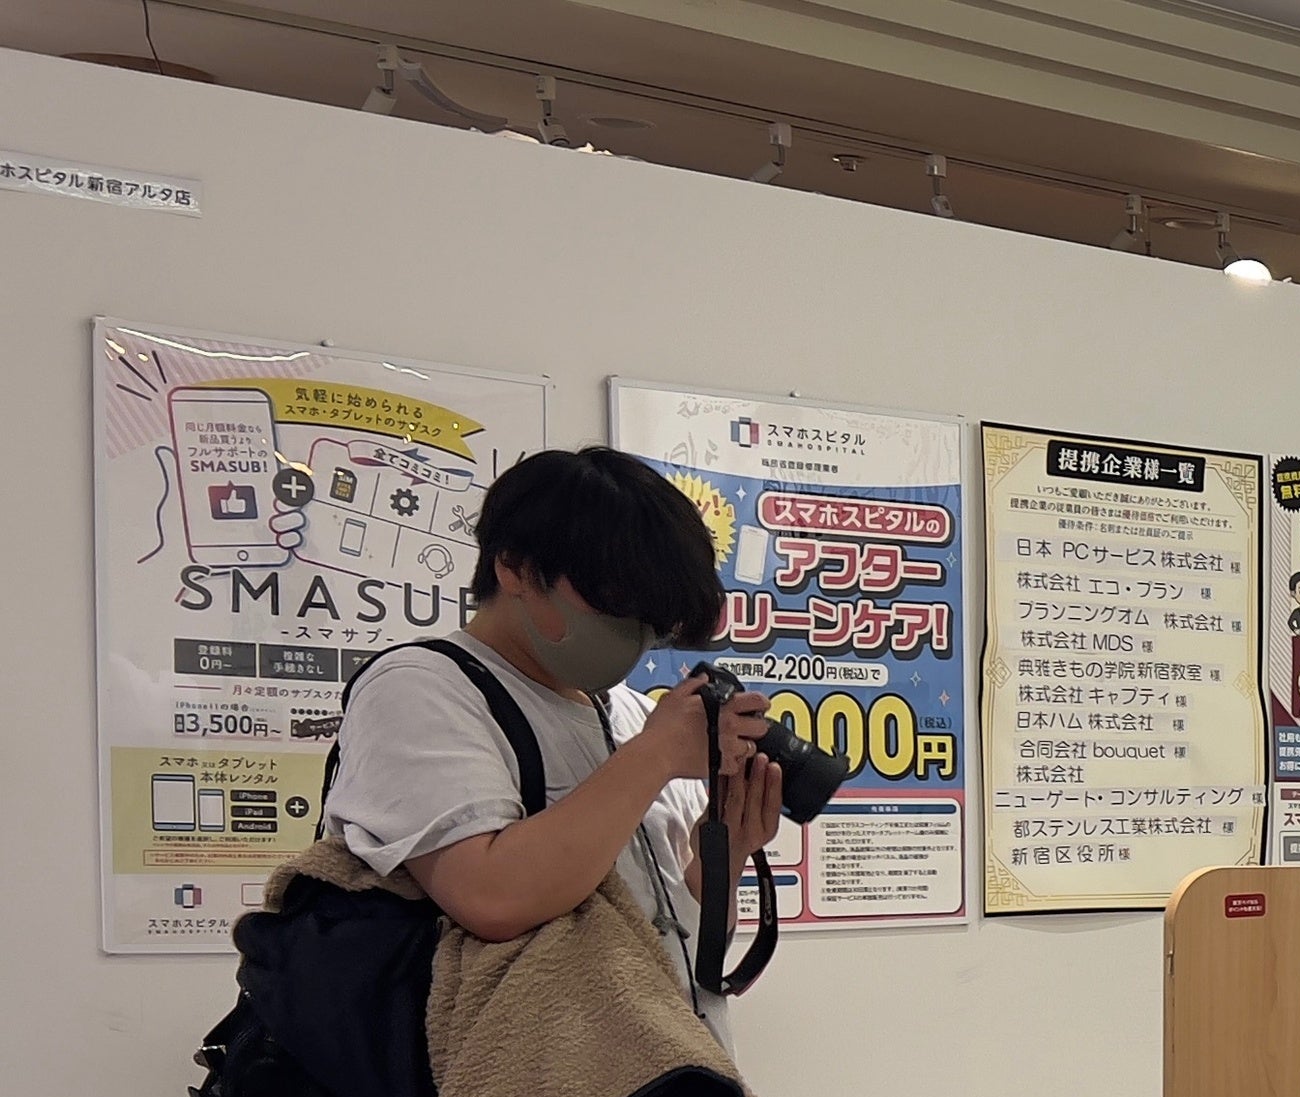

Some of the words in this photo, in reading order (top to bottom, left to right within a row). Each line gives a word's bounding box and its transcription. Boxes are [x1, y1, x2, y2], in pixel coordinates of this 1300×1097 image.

[296, 387, 423, 418] 気軽に始められる
[767, 423, 866, 447] スマホスピタル
[188, 447, 268, 458] フルサポートの
[191, 460, 267, 473] SMASUB!
[1058, 448, 1196, 484] 提携企業様一覧
[774, 501, 940, 534] スマホスピタルの
[778, 540, 938, 587] アフター
[1017, 538, 1051, 557] 日本
[1230, 562, 1241, 574] 様
[1017, 572, 1080, 592] 株式会社
[1201, 588, 1211, 599] 様
[1164, 613, 1223, 632] 株式会社
[1232, 621, 1242, 632] 様
[1021, 631, 1085, 650] 株式会社
[1093, 635, 1133, 651] MDS
[1142, 641, 1152, 653] 様
[1018, 659, 1202, 681] 典雅きもの学院新宿教室
[1210, 669, 1221, 682] 様
[1019, 684, 1083, 704] 株式会社
[1175, 695, 1187, 708] 様
[919, 716, 952, 730] (税込)
[1173, 719, 1184, 732] 様
[1020, 740, 1087, 759] 合同会社
[1093, 742, 1165, 759] bouquet
[1174, 746, 1185, 759] 様
[200, 771, 278, 784] 本体レンタル
[1017, 765, 1084, 784] 株式会社
[1252, 792, 1264, 805] 様
[1014, 817, 1212, 838] 都ステンレス工業株式会社
[1223, 821, 1234, 834] 様
[1012, 844, 1114, 866] 新宿区役所
[1119, 848, 1130, 860] 様
[148, 918, 229, 928] スマホスピタル
